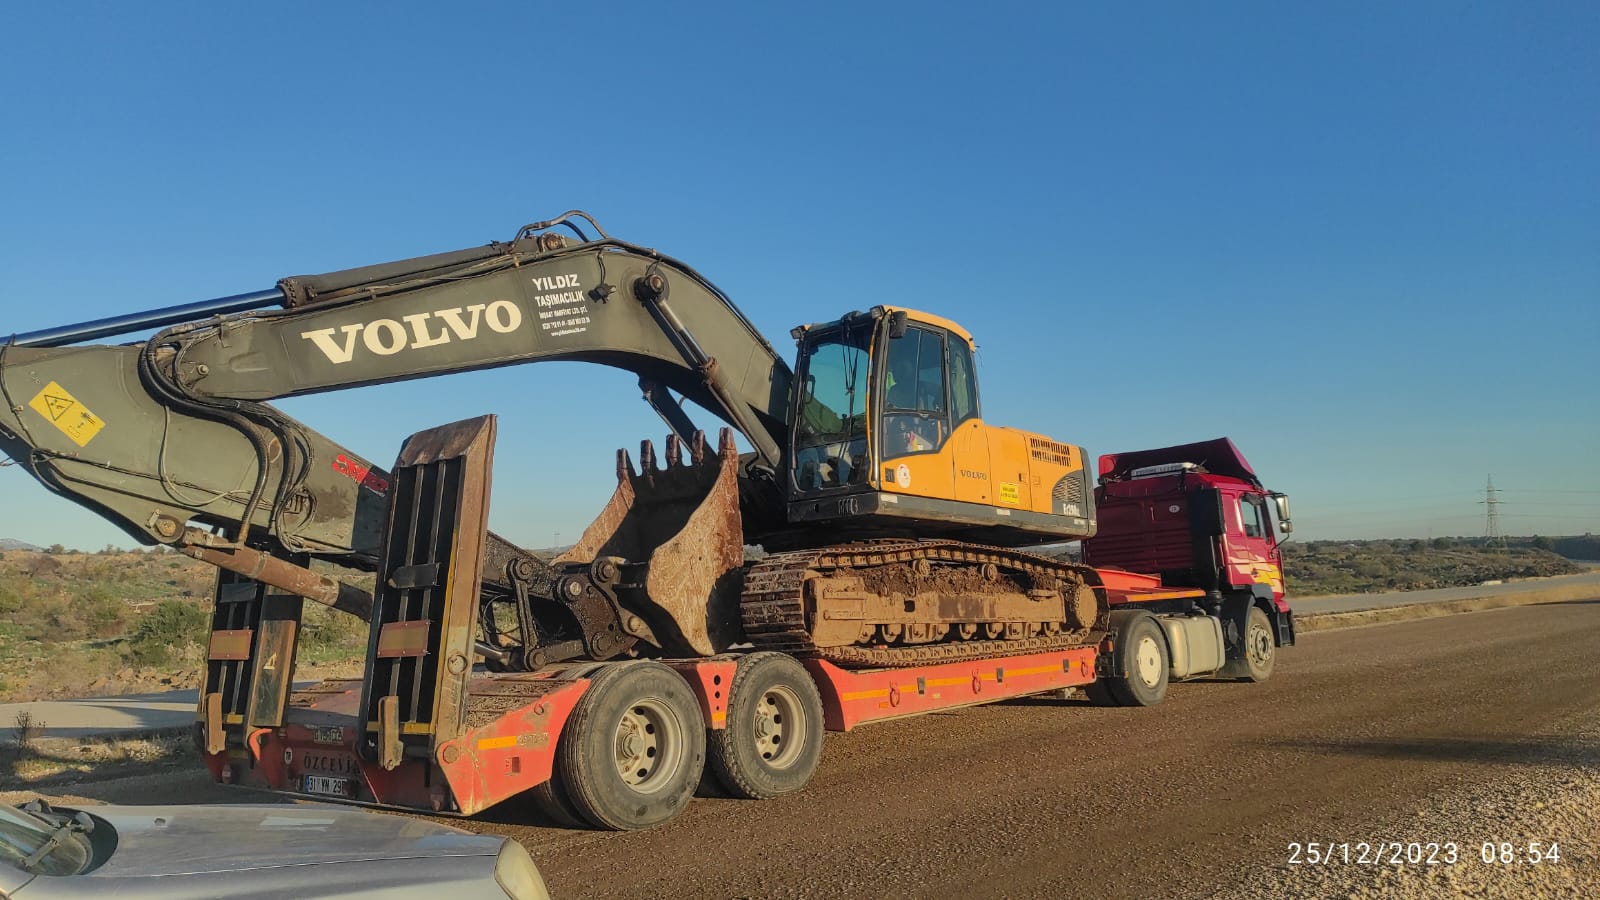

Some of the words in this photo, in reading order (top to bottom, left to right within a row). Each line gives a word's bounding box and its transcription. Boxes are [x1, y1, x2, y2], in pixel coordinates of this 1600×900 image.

[531, 273, 581, 291] YILDIZ
[534, 290, 585, 309] TAŞIMACILIK
[301, 300, 522, 364] VOLVO
[960, 469, 987, 480] VOLVO
